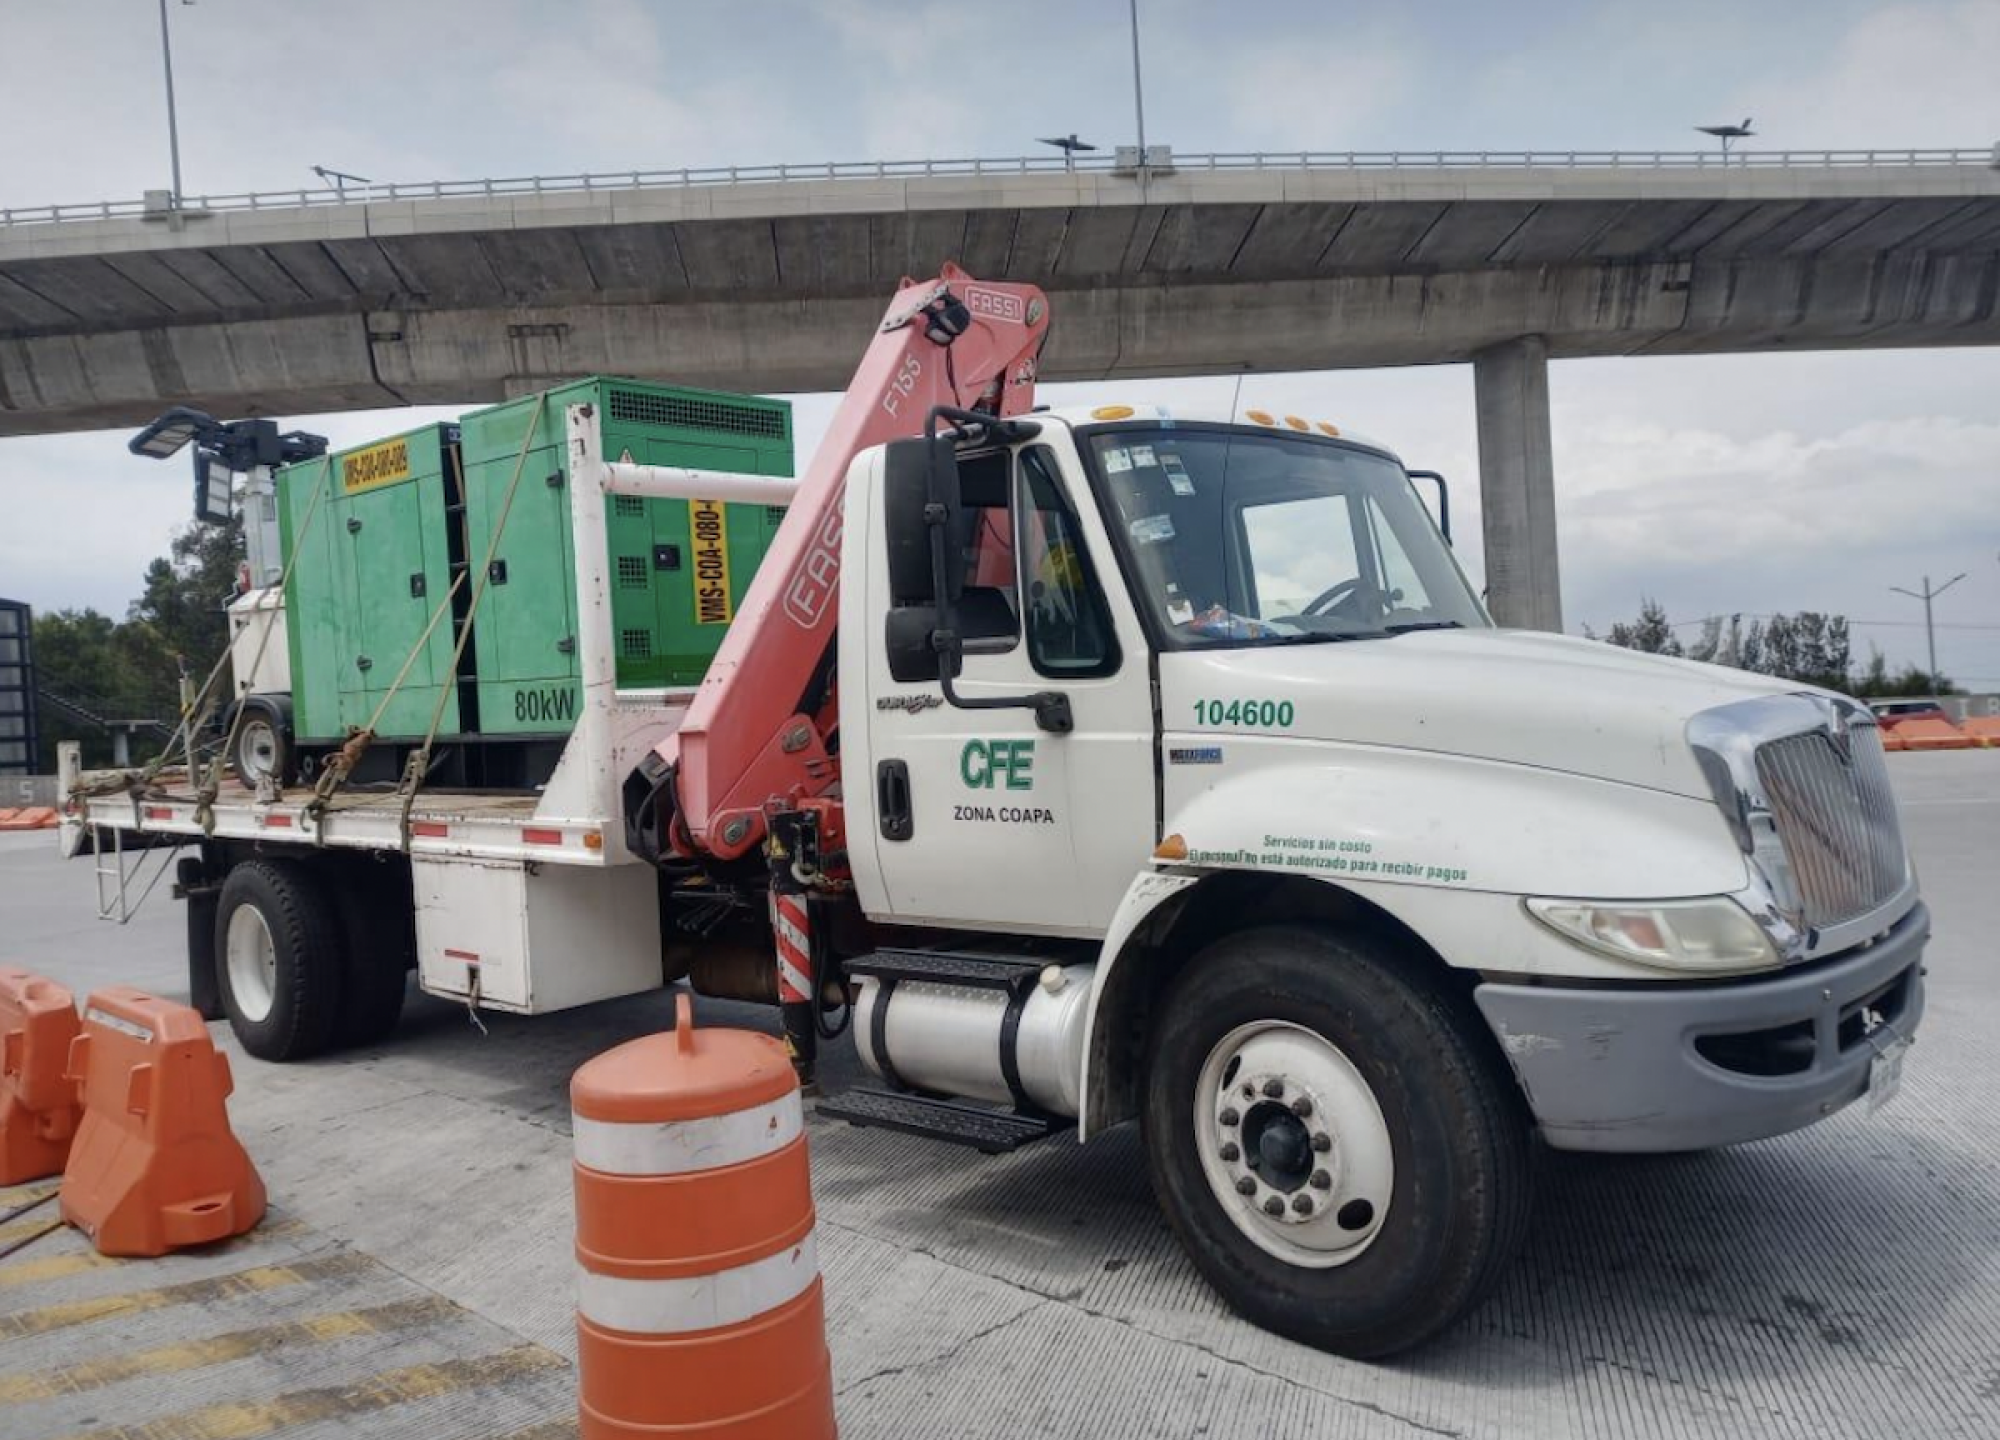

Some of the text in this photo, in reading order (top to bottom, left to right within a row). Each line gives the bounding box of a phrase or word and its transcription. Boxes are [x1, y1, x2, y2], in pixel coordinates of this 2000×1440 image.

[970, 292, 1020, 318] FASSI
[882, 354, 921, 417] F155
[515, 687, 575, 722] 80kW
[1193, 699, 1294, 727] 104600
[961, 738, 1035, 790] CFE
[954, 806, 1055, 824] ZONA COAPA
[1264, 834, 1372, 853] Servicios sin costo
[1261, 852, 1283, 865] está
[1286, 854, 1348, 869] autorizado
[1351, 861, 1378, 872] para
[1381, 862, 1424, 876] recibir
[1427, 866, 1468, 882] pagos
